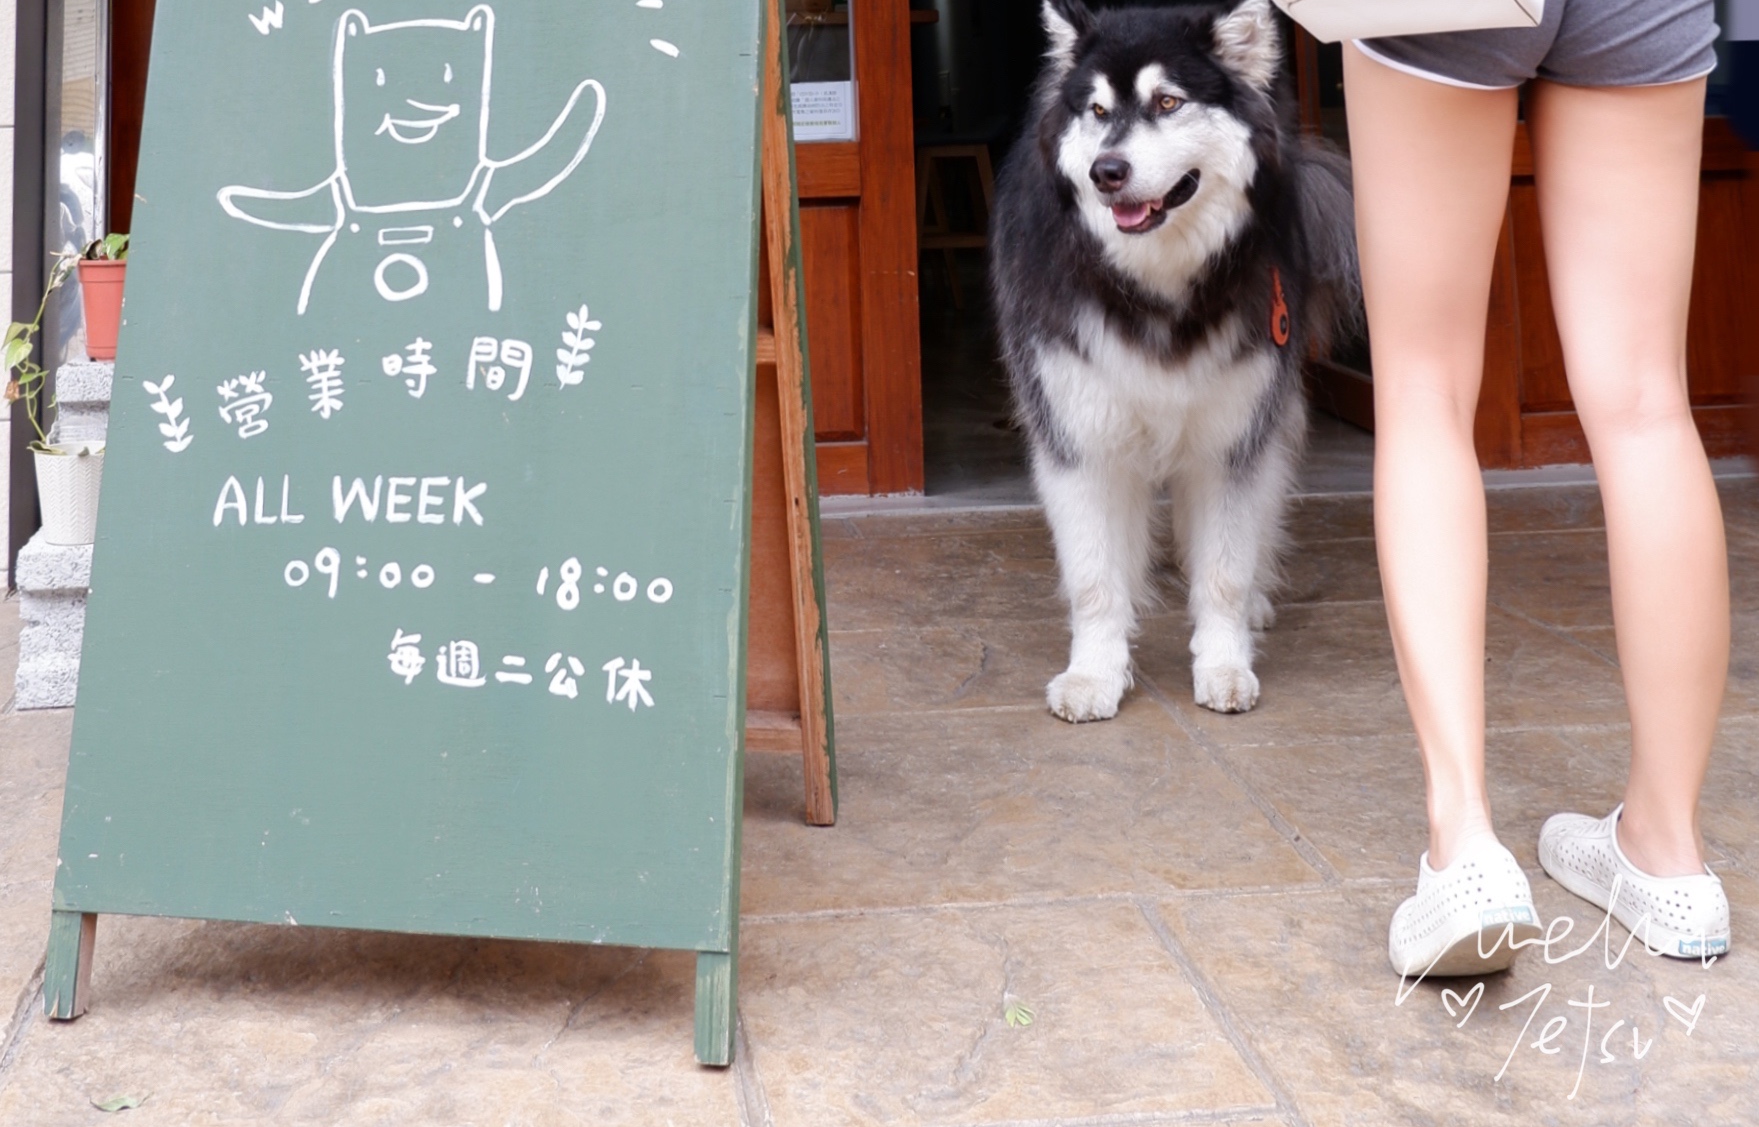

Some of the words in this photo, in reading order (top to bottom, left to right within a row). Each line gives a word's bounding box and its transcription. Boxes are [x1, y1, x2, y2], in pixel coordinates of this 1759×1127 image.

[216, 336, 533, 439] 營業時間
[212, 474, 305, 527] ALL
[331, 475, 488, 527] WEEK
[284, 546, 436, 599] 09:00
[536, 557, 674, 611] 18:00
[387, 629, 655, 713] 每週二公休
[1483, 908, 1532, 923] native
